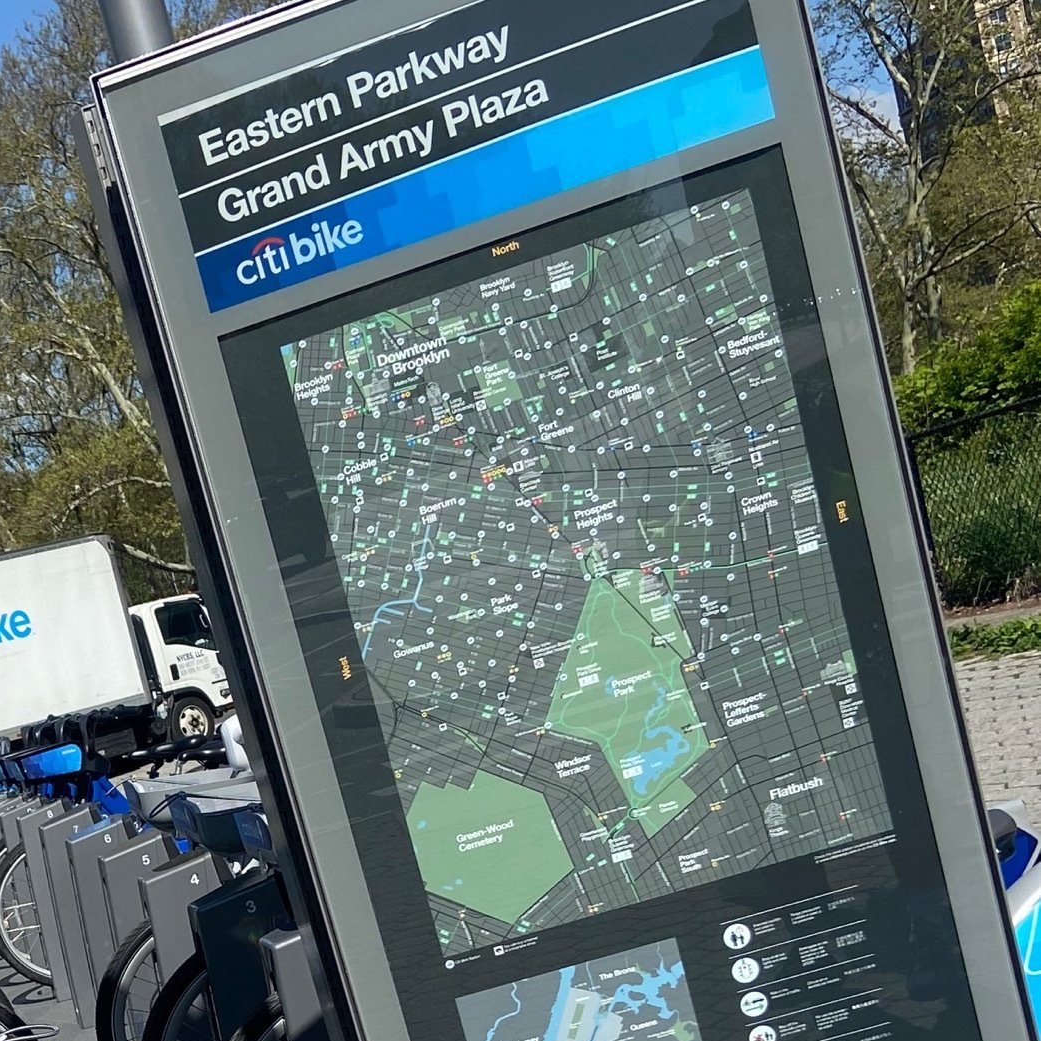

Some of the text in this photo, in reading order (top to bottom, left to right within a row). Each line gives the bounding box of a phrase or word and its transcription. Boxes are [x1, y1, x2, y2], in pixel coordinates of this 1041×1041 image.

[198, 25, 512, 167] Eastern Parkway
[217, 76, 549, 223] Grand Army Plaza
[235, 215, 364, 286] citi bike
[491, 241, 520, 257] North
[479, 276, 510, 292] Brooklyn
[481, 282, 516, 298] Navy Yard
[727, 330, 768, 350] Bedford-
[729, 337, 781, 359] Stuyvesant
[376, 337, 447, 367] Downtown
[391, 349, 450, 375] Brooklyn
[482, 364, 498, 373] Fort
[393, 375, 420, 387] MetroTech
[484, 367, 509, 380] Greene
[486, 377, 503, 386] Park
[294, 373, 334, 392] Brooklyn
[296, 384, 330, 400] Heights
[607, 384, 640, 399] Clinton
[627, 392, 642, 402] Hill
[538, 421, 559, 433] Fort
[540, 425, 574, 441] Greene
[343, 458, 377, 475] Cobble
[345, 474, 361, 486] Hill
[419, 498, 457, 515] Boerum
[741, 491, 772, 506] Crown
[574, 499, 618, 519] Prospect
[742, 498, 779, 516] Heights
[835, 500, 849, 524] East
[421, 513, 437, 525] Hill
[576, 513, 614, 530] Heights
[490, 594, 512, 607] Park
[492, 601, 519, 615] Slope
[195, 649, 204, 658] LLC
[393, 641, 435, 659] Gowanus
[338, 656, 352, 681] West
[611, 670, 652, 689] Prospect
[614, 684, 635, 697] Park
[722, 692, 767, 710] Prospect-
[724, 702, 759, 719] Lefferts
[726, 710, 765, 728] Gardens
[554, 753, 592, 770] Windsor
[557, 764, 591, 779] Terrace
[769, 777, 823, 800] Flatbush
[47, 810, 54, 818] 8
[72, 825, 79, 833] 7
[456, 819, 514, 843] Green-Wood
[104, 834, 112, 843] 6
[459, 834, 504, 852] Cemetery
[142, 855, 150, 865] 5
[678, 848, 709, 862] Prospect
[680, 859, 696, 867] Park
[681, 863, 702, 874] South
[190, 874, 199, 885] 4
[245, 900, 256, 913] 3
[599, 966, 636, 981] The Bronx
[629, 1019, 658, 1032] Queens
